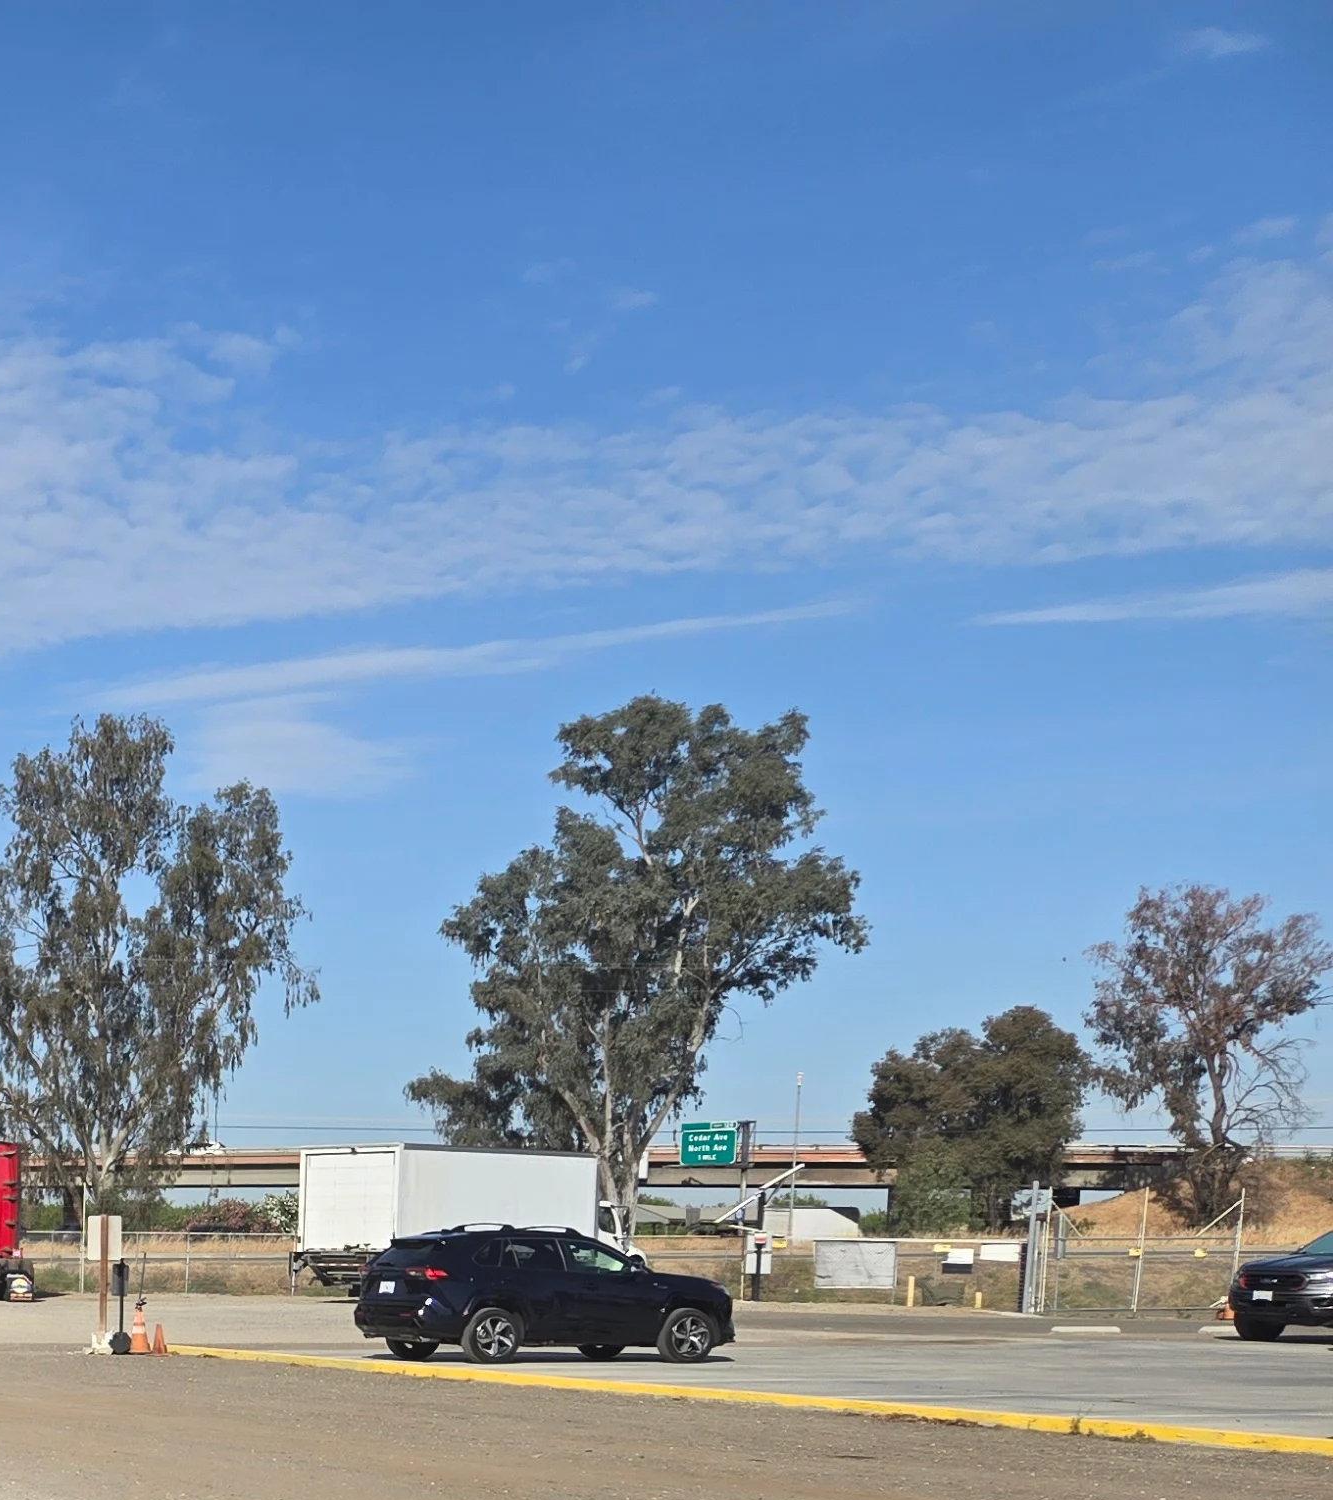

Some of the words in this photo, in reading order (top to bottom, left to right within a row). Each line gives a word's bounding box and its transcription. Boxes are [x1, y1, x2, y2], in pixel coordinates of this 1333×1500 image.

[688, 1133, 711, 1141] Cedar
[713, 1133, 728, 1141] Ave
[688, 1144, 710, 1152] North
[712, 1143, 727, 1151] Ave
